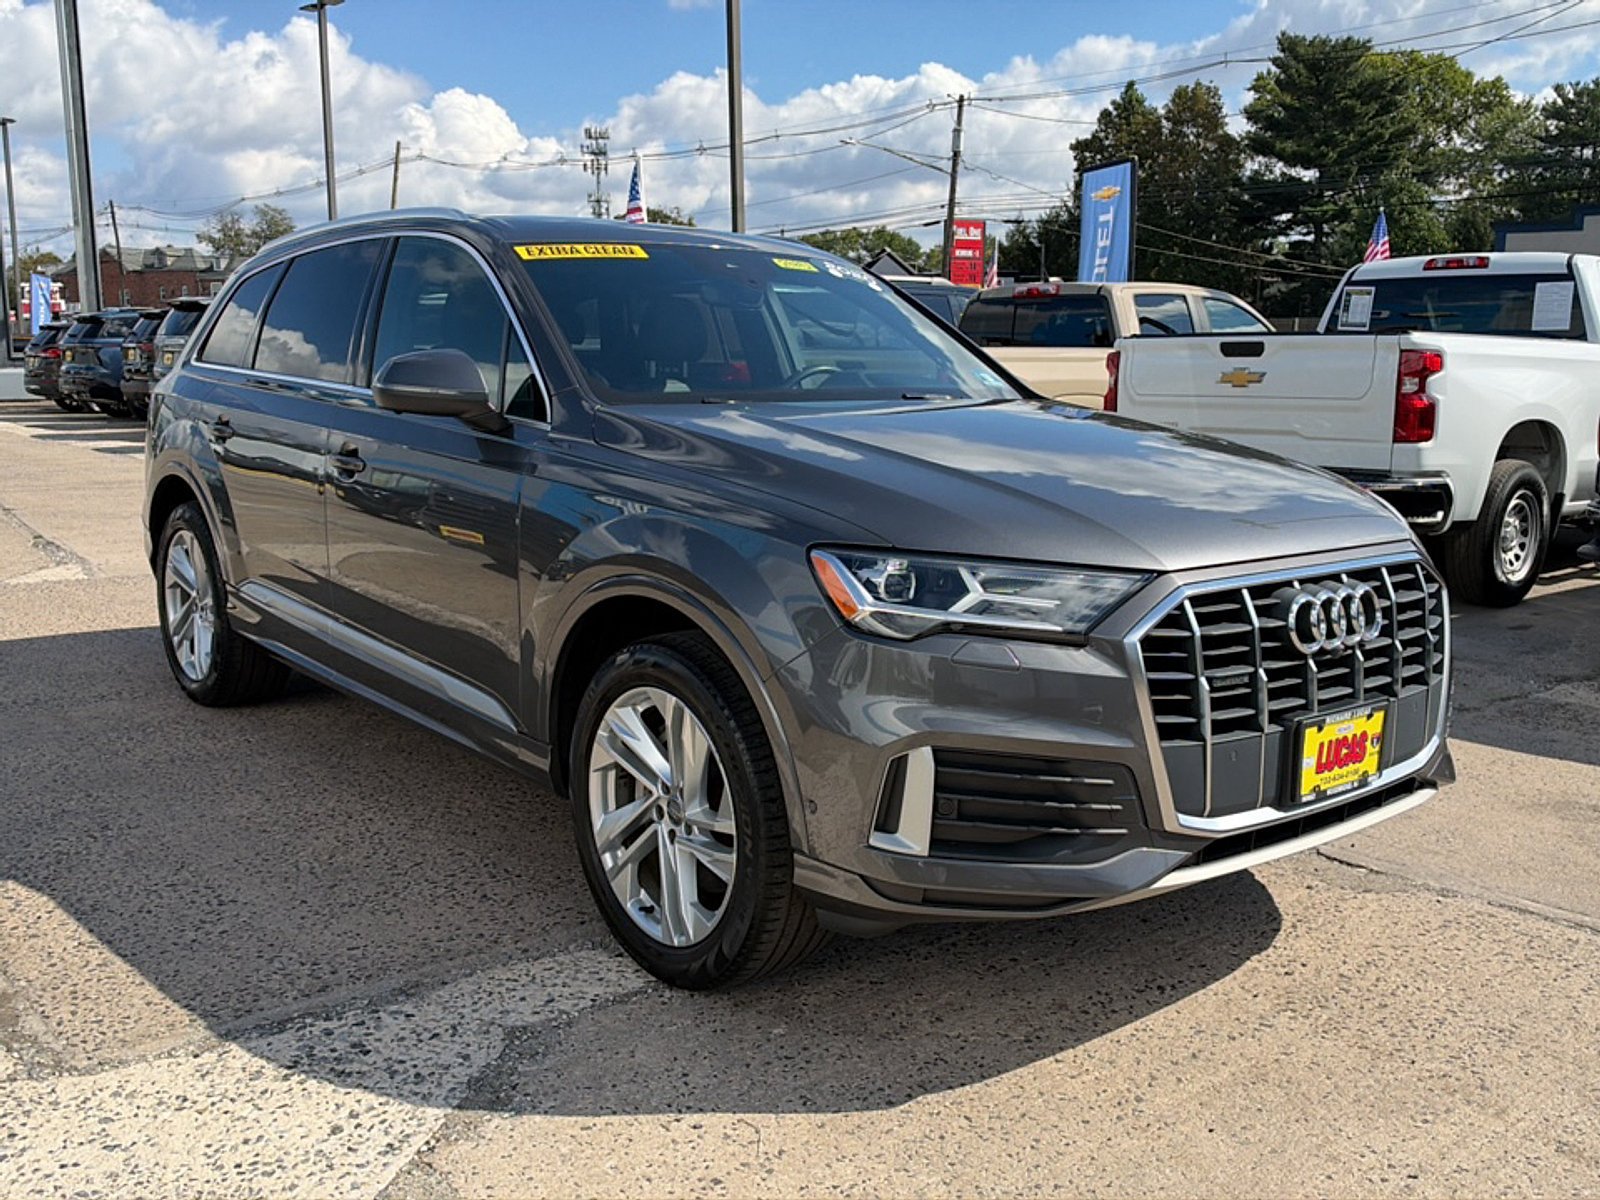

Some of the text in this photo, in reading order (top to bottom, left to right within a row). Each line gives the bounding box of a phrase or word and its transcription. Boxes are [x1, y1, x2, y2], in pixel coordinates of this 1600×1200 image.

[524, 245, 636, 257] EXTRA CLEAN
[1316, 731, 1368, 774] LUCAS
